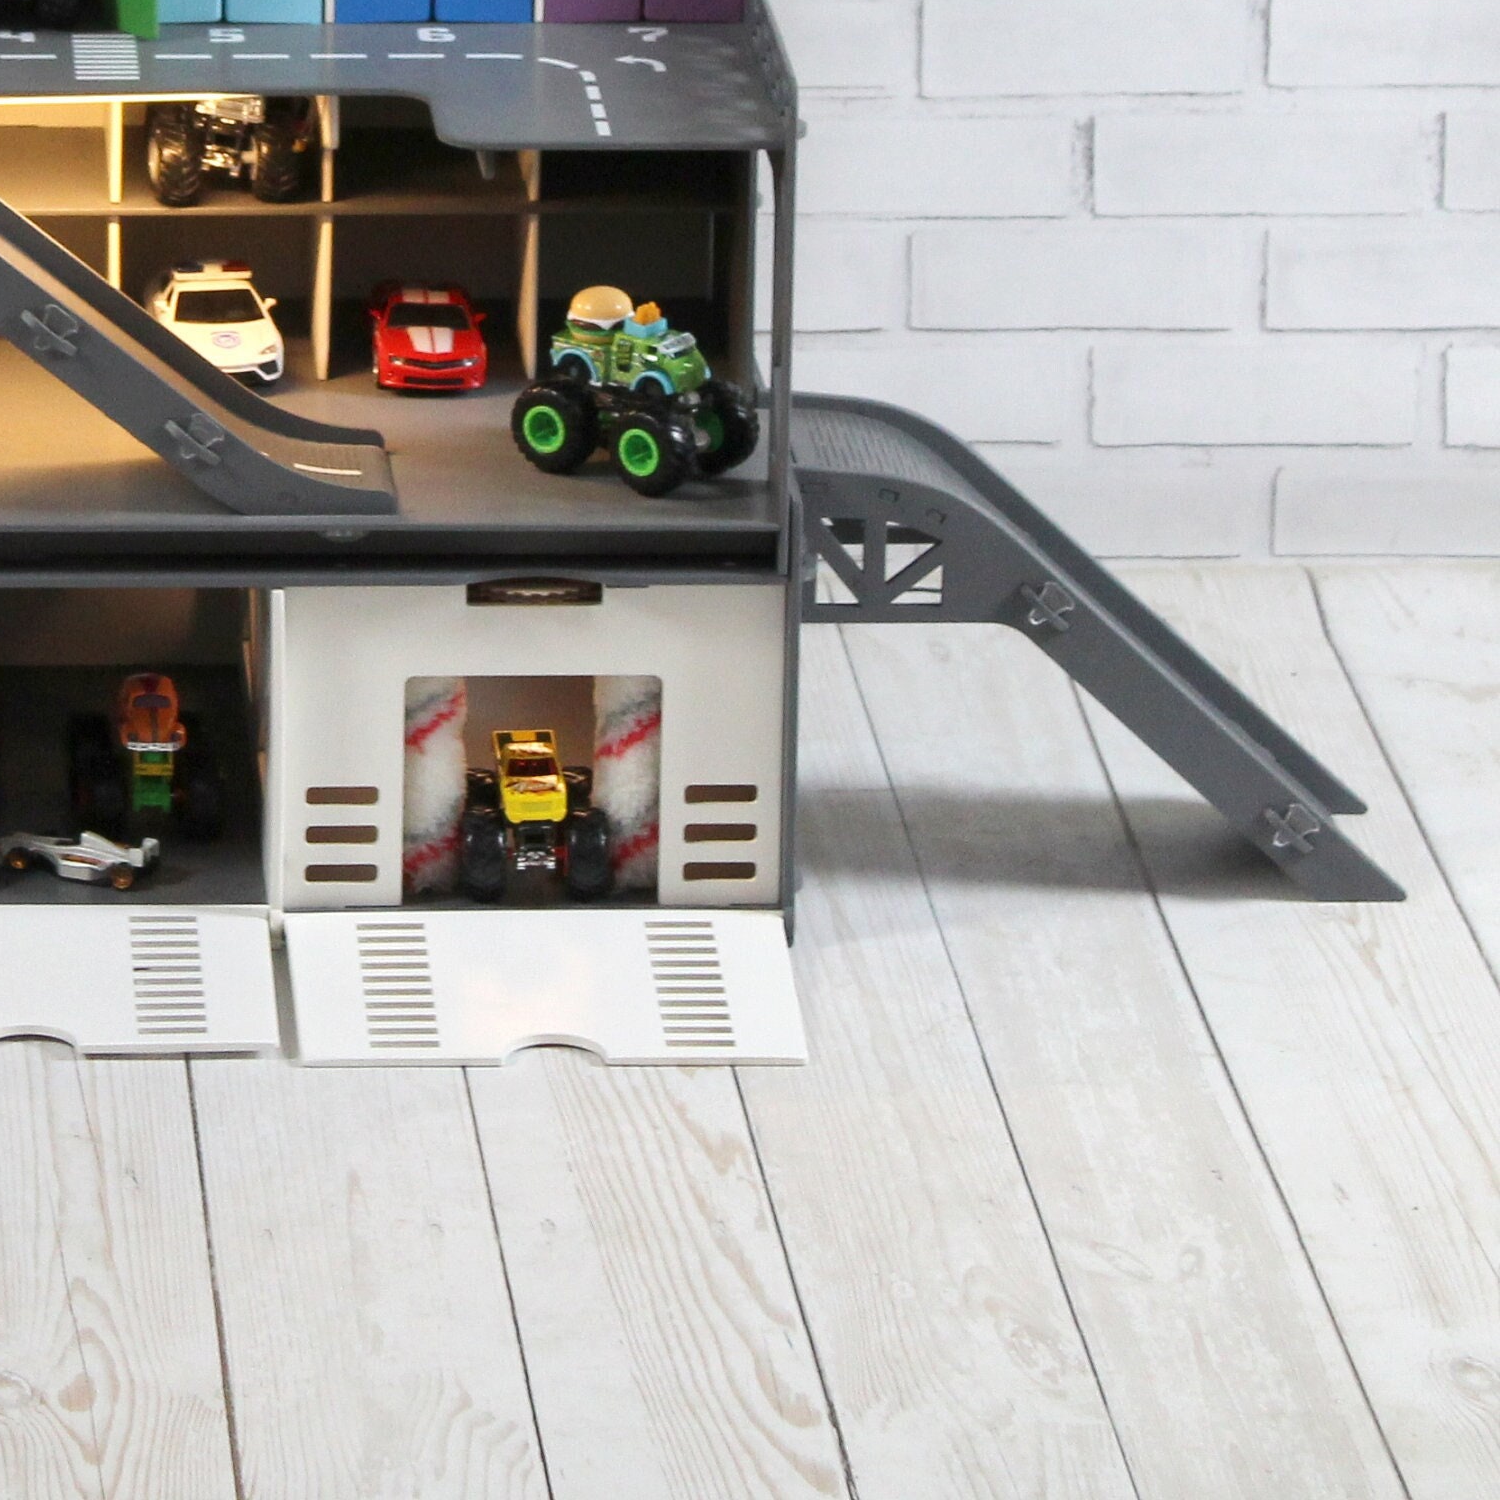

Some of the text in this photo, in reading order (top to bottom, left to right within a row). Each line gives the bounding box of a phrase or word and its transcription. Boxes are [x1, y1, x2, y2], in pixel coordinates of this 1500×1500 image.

[209, 28, 246, 43] 5
[416, 27, 457, 43] 6
[627, 26, 669, 43] 7
